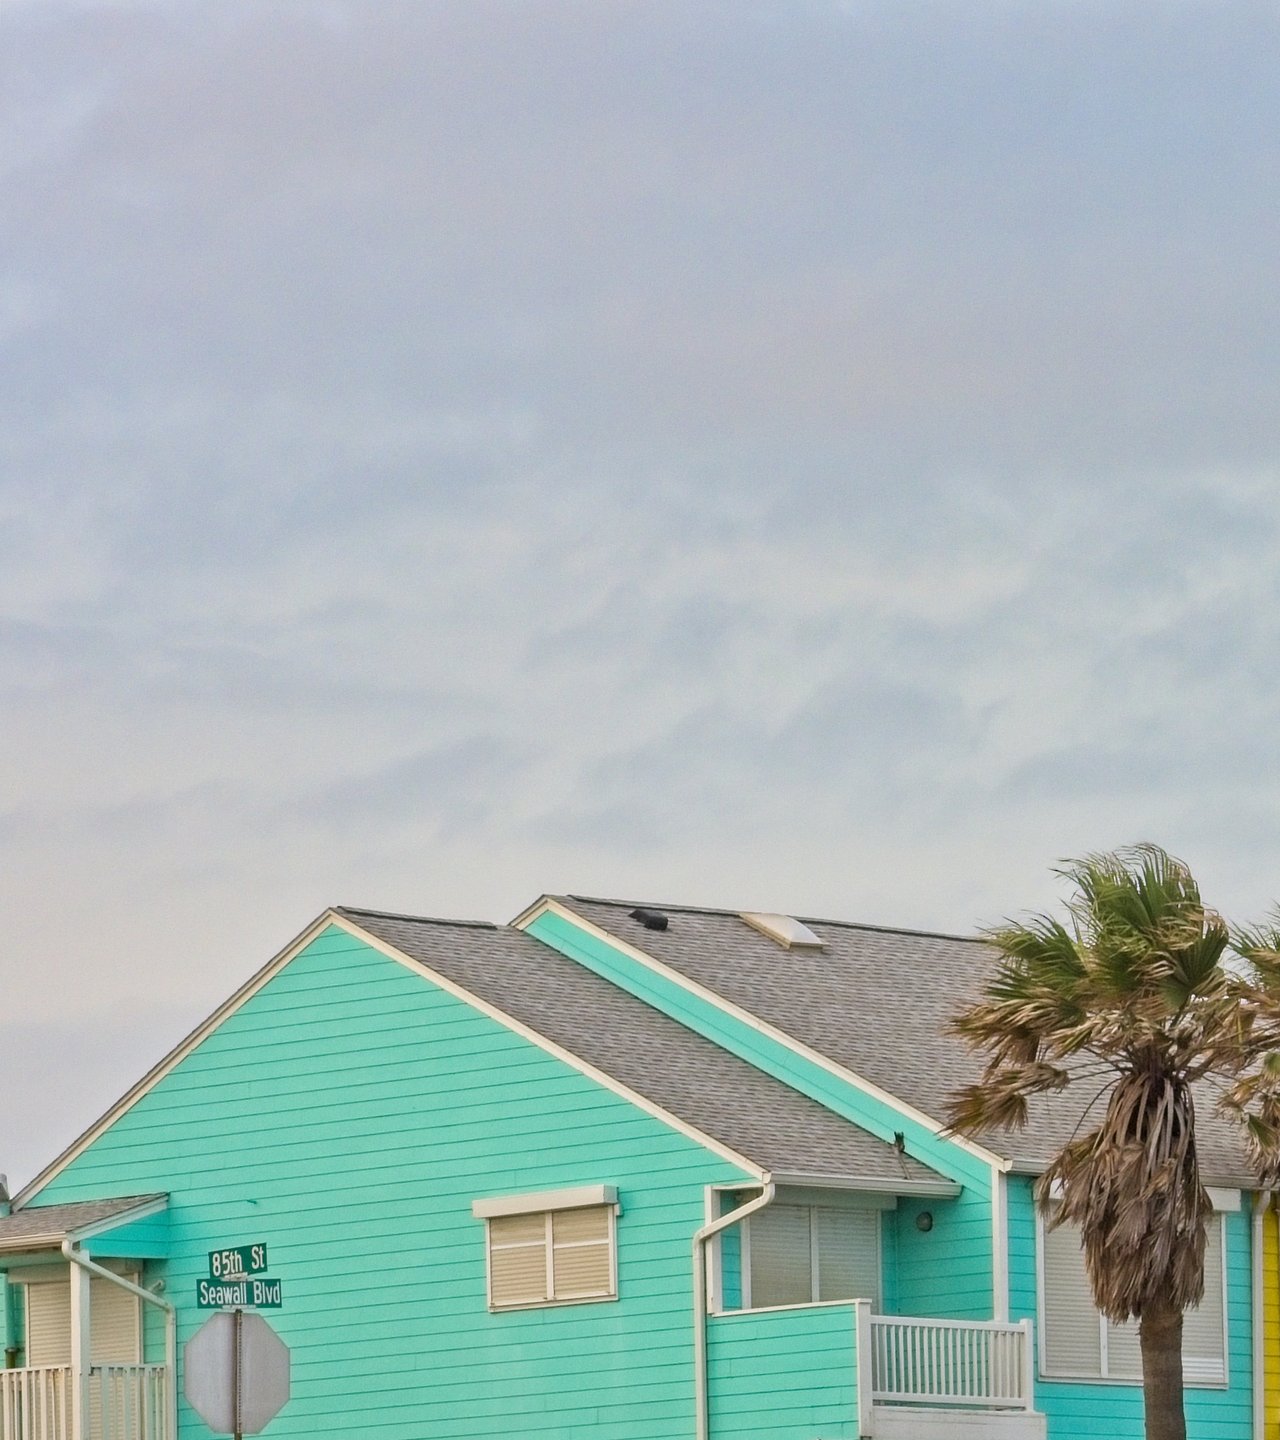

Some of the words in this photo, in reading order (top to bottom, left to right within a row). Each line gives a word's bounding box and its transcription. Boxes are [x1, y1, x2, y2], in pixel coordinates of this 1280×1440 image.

[212, 1250, 242, 1277] 85th
[251, 1246, 265, 1270] St
[200, 1281, 247, 1305] Seawall
[253, 1281, 281, 1304] Blvd
